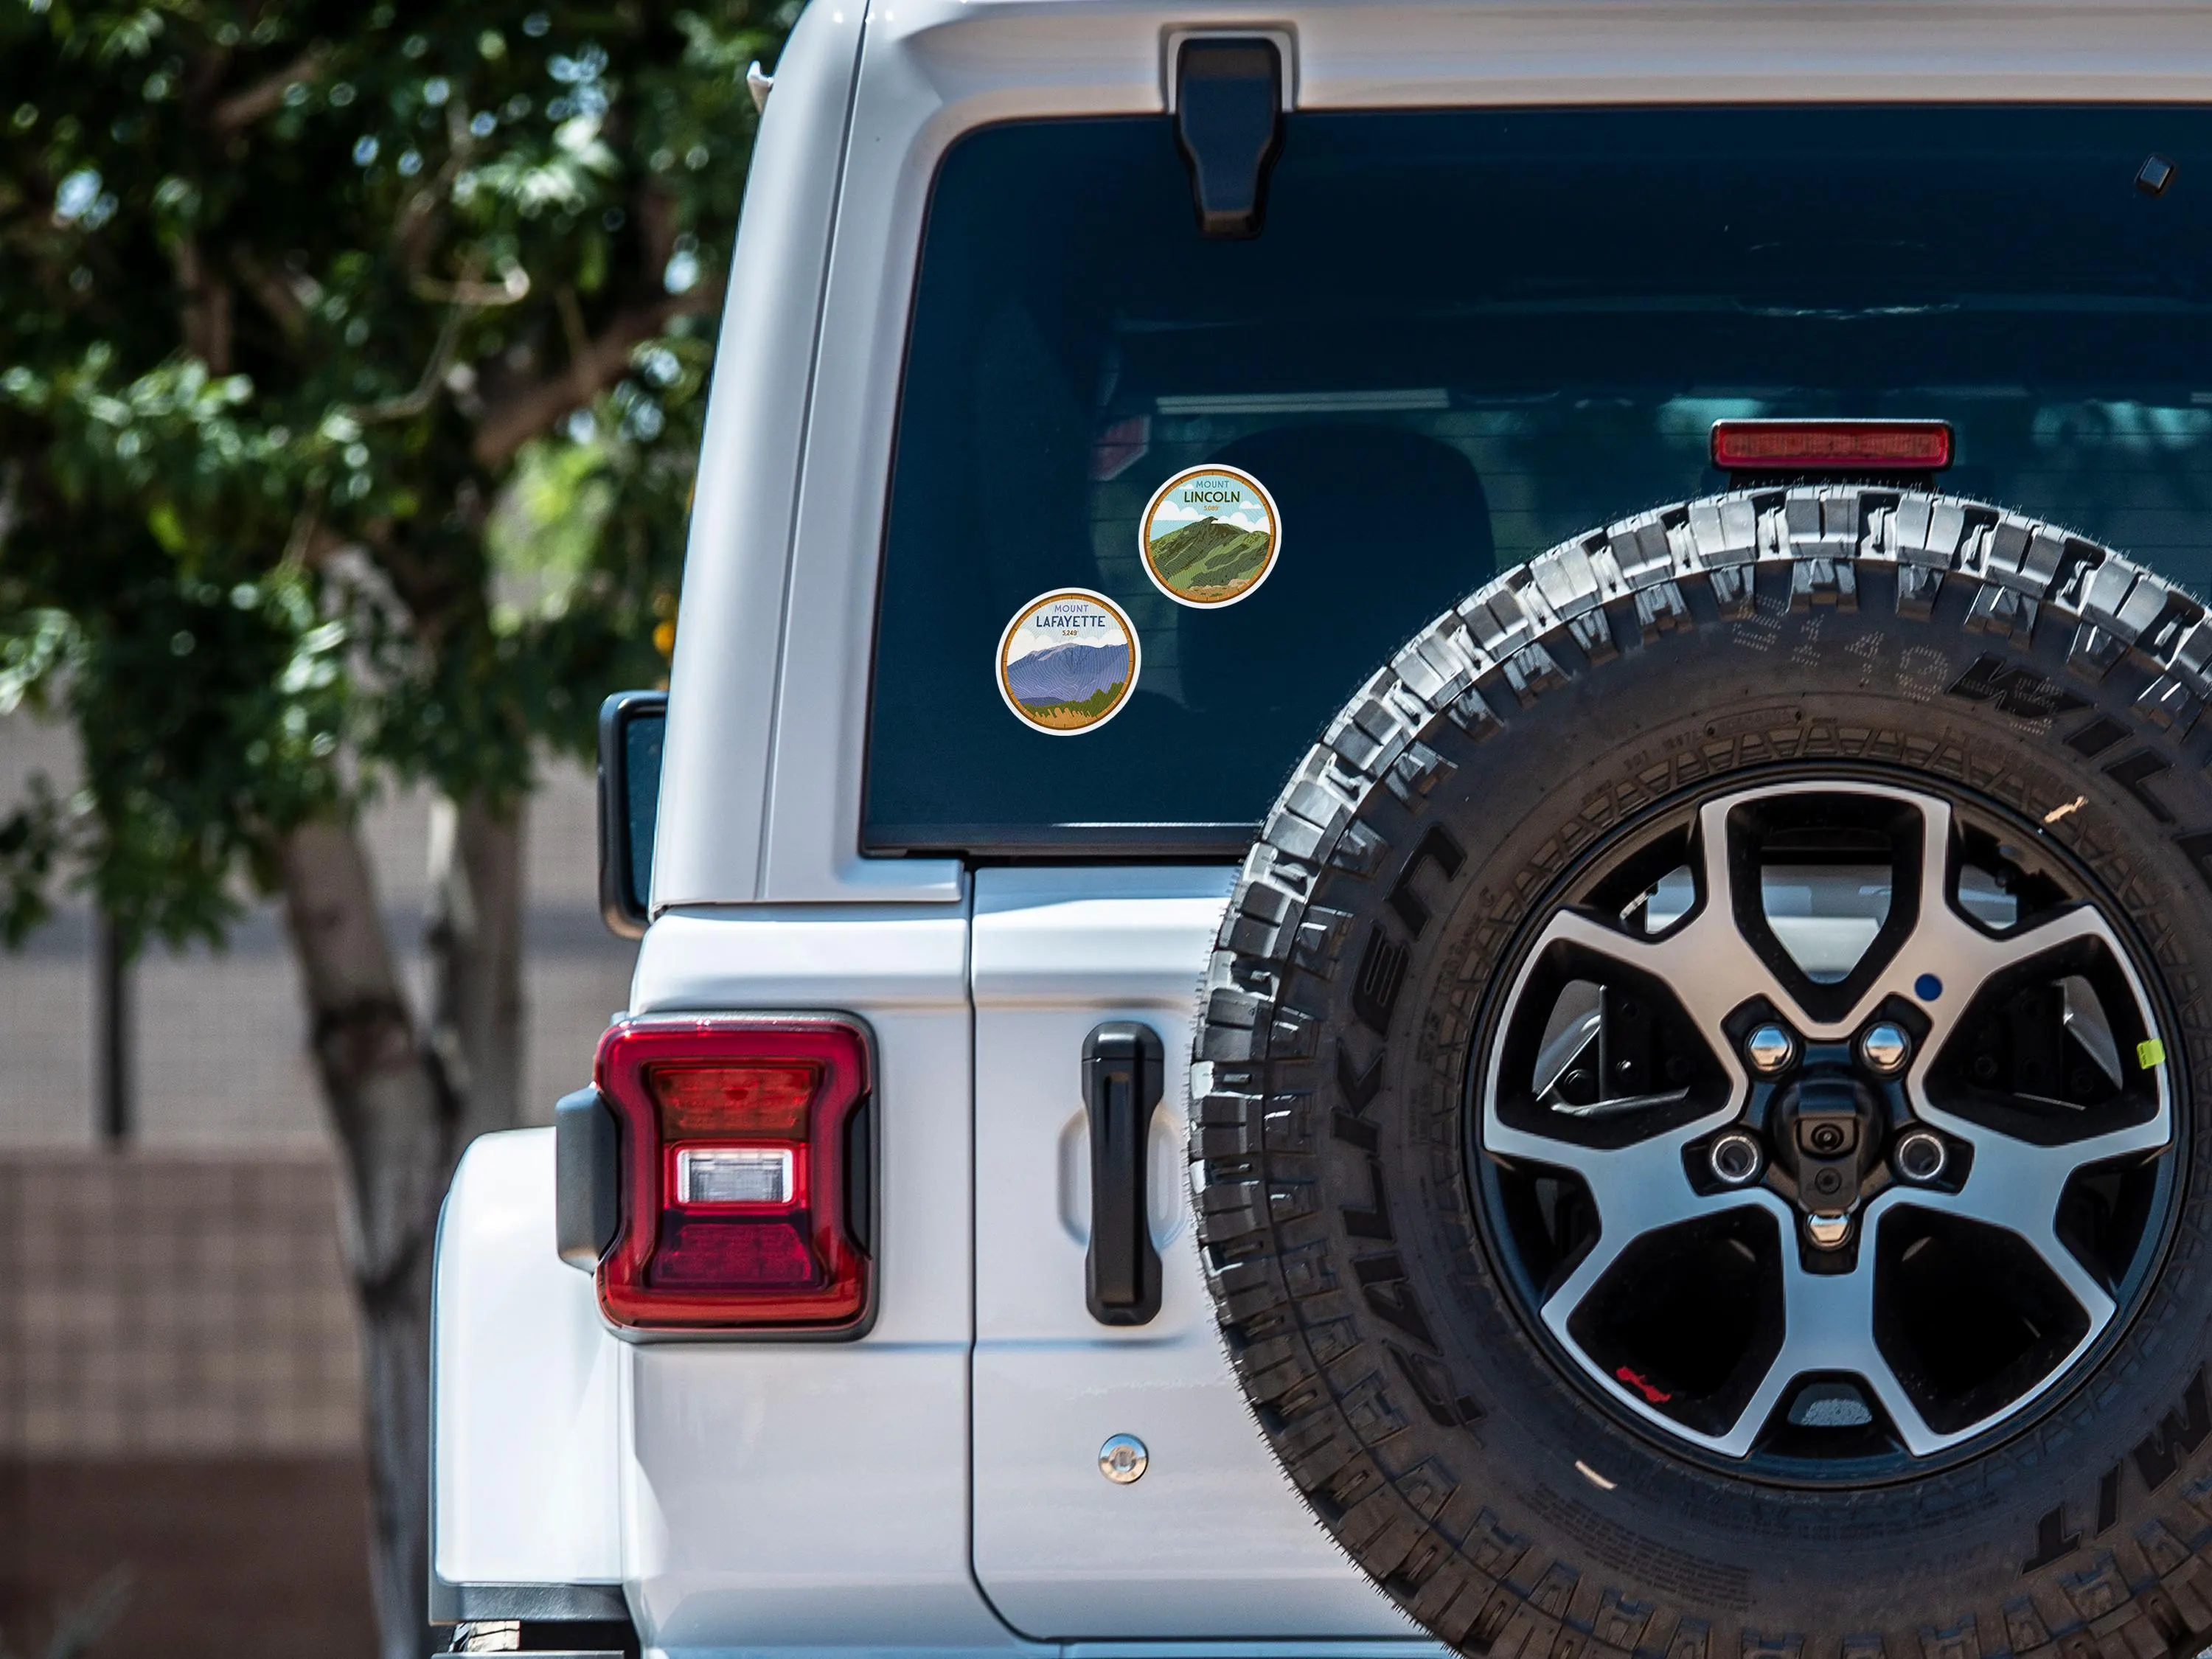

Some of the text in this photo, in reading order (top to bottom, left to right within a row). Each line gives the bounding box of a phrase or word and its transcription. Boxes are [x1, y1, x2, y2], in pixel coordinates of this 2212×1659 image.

[1196, 480, 1230, 488] MOUNT
[1184, 491, 1240, 503] LINCOLN
[1054, 605, 1089, 613] MOUNT
[1037, 616, 1106, 627] LAFAYETTE
